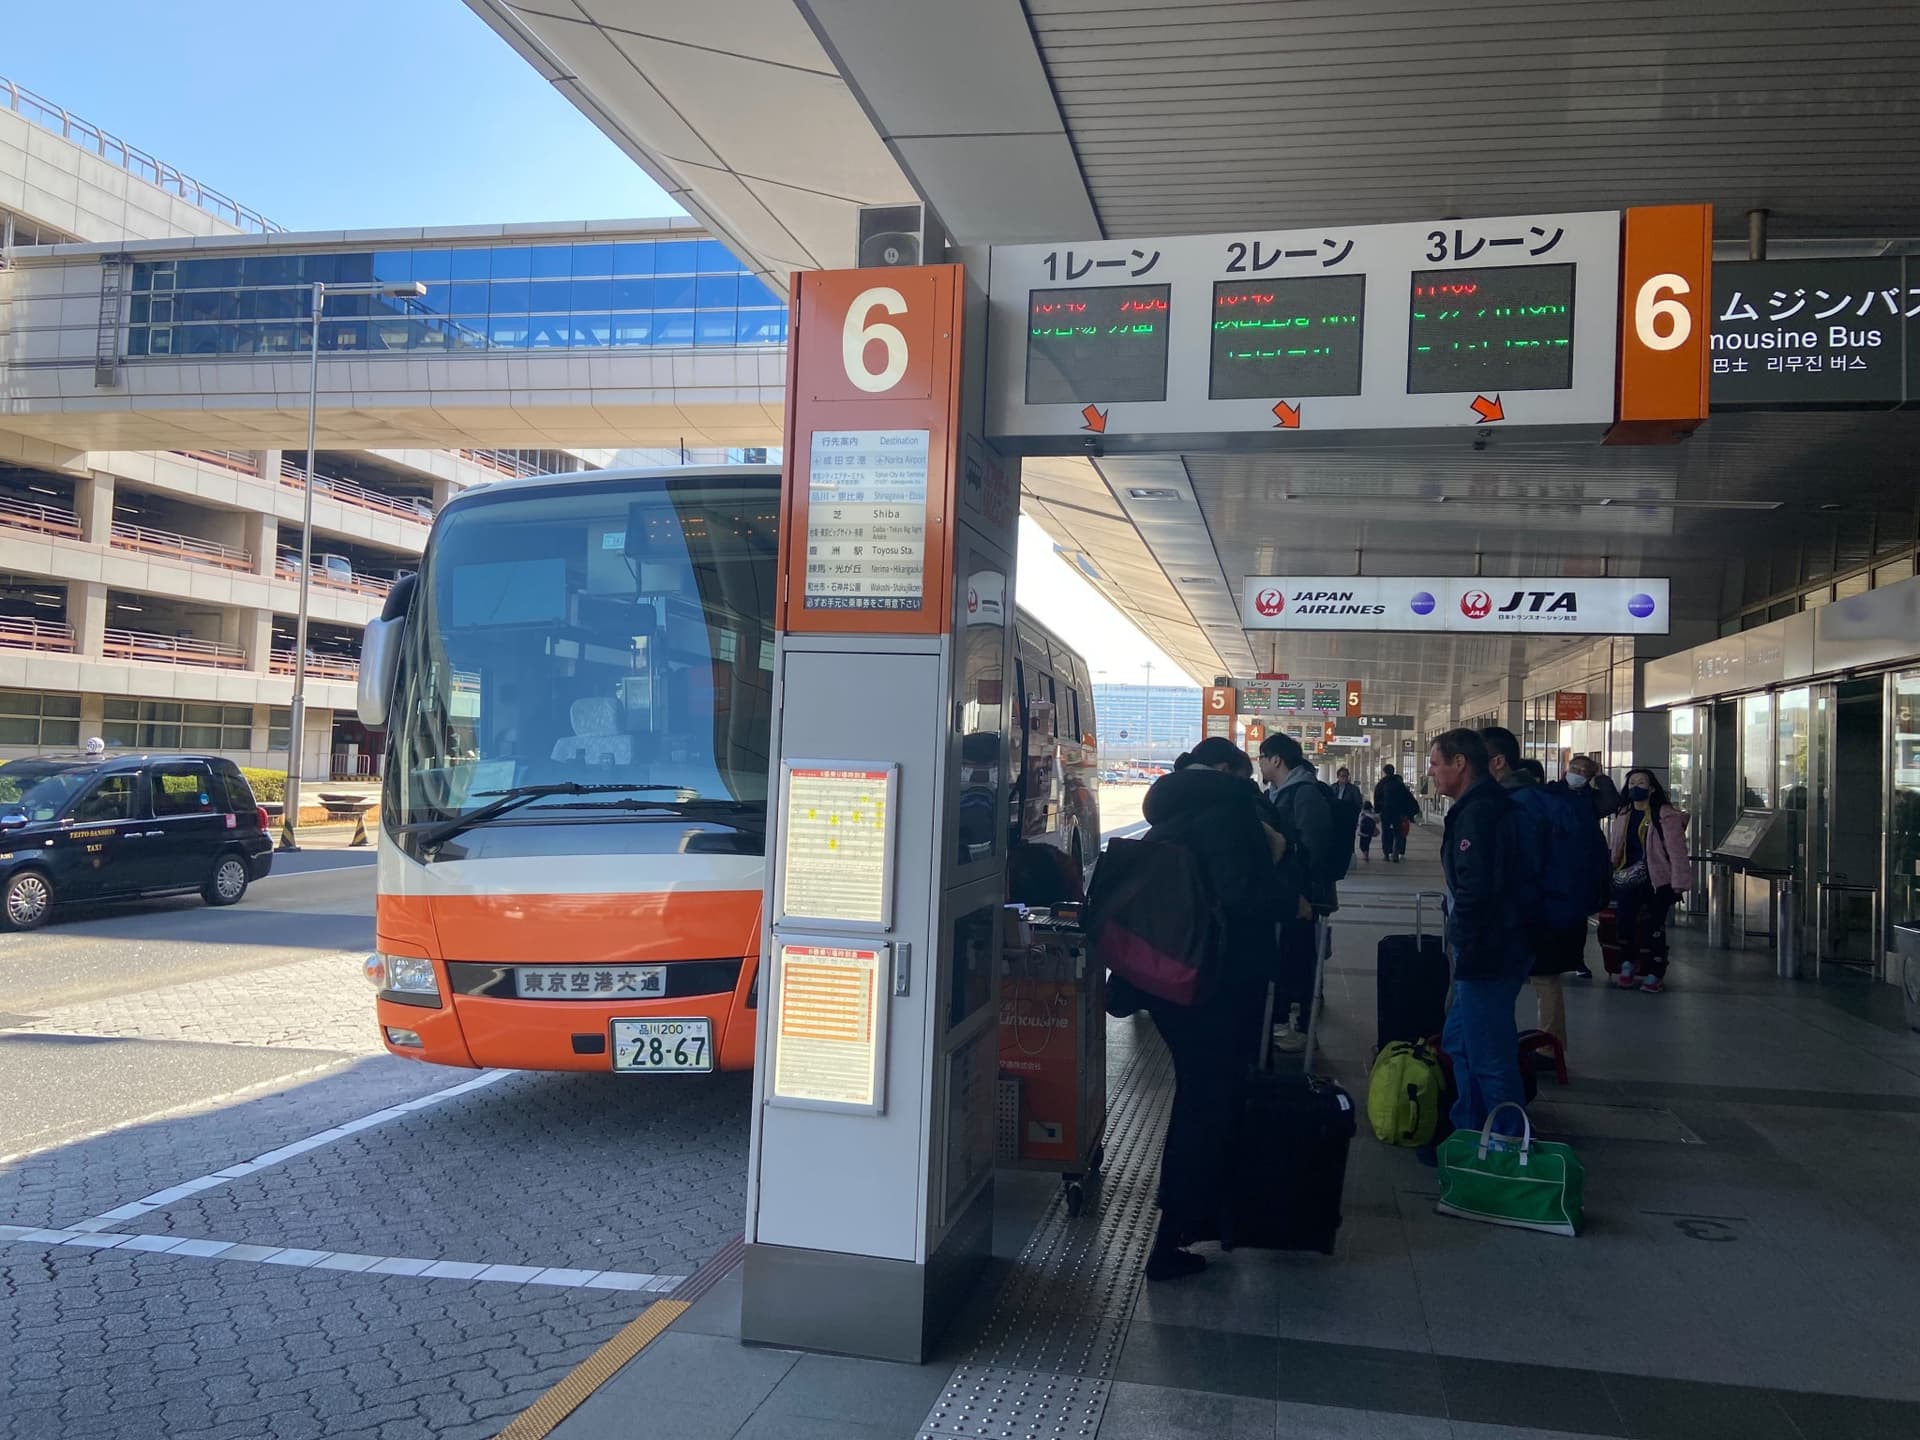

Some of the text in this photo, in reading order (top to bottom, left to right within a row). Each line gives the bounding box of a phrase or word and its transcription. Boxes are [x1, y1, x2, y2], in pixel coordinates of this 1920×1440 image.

[1426, 226, 1564, 262] 3レーン
[1226, 238, 1354, 272] 2レーン
[1043, 249, 1160, 281] 1レーン
[1635, 273, 1692, 351] 6
[842, 286, 909, 393] 6
[1829, 326, 1882, 348] Bus
[1713, 358, 1749, 373] 巴士
[1768, 355, 1868, 373] 리무진 버스
[880, 436, 919, 445] Destination
[873, 509, 900, 519] Shiba
[872, 546, 914, 556] Toyosu Sta.
[1292, 592, 1354, 601] JAPAN
[1499, 591, 1578, 613] JTA
[1295, 605, 1386, 615] AIRLINES
[1211, 690, 1225, 709] 5
[1349, 692, 1359, 706] 5
[1250, 726, 1259, 738] 4
[1325, 727, 1332, 736] 4
[524, 971, 660, 993] 東京空港交通
[631, 1037, 706, 1066] 28-67
